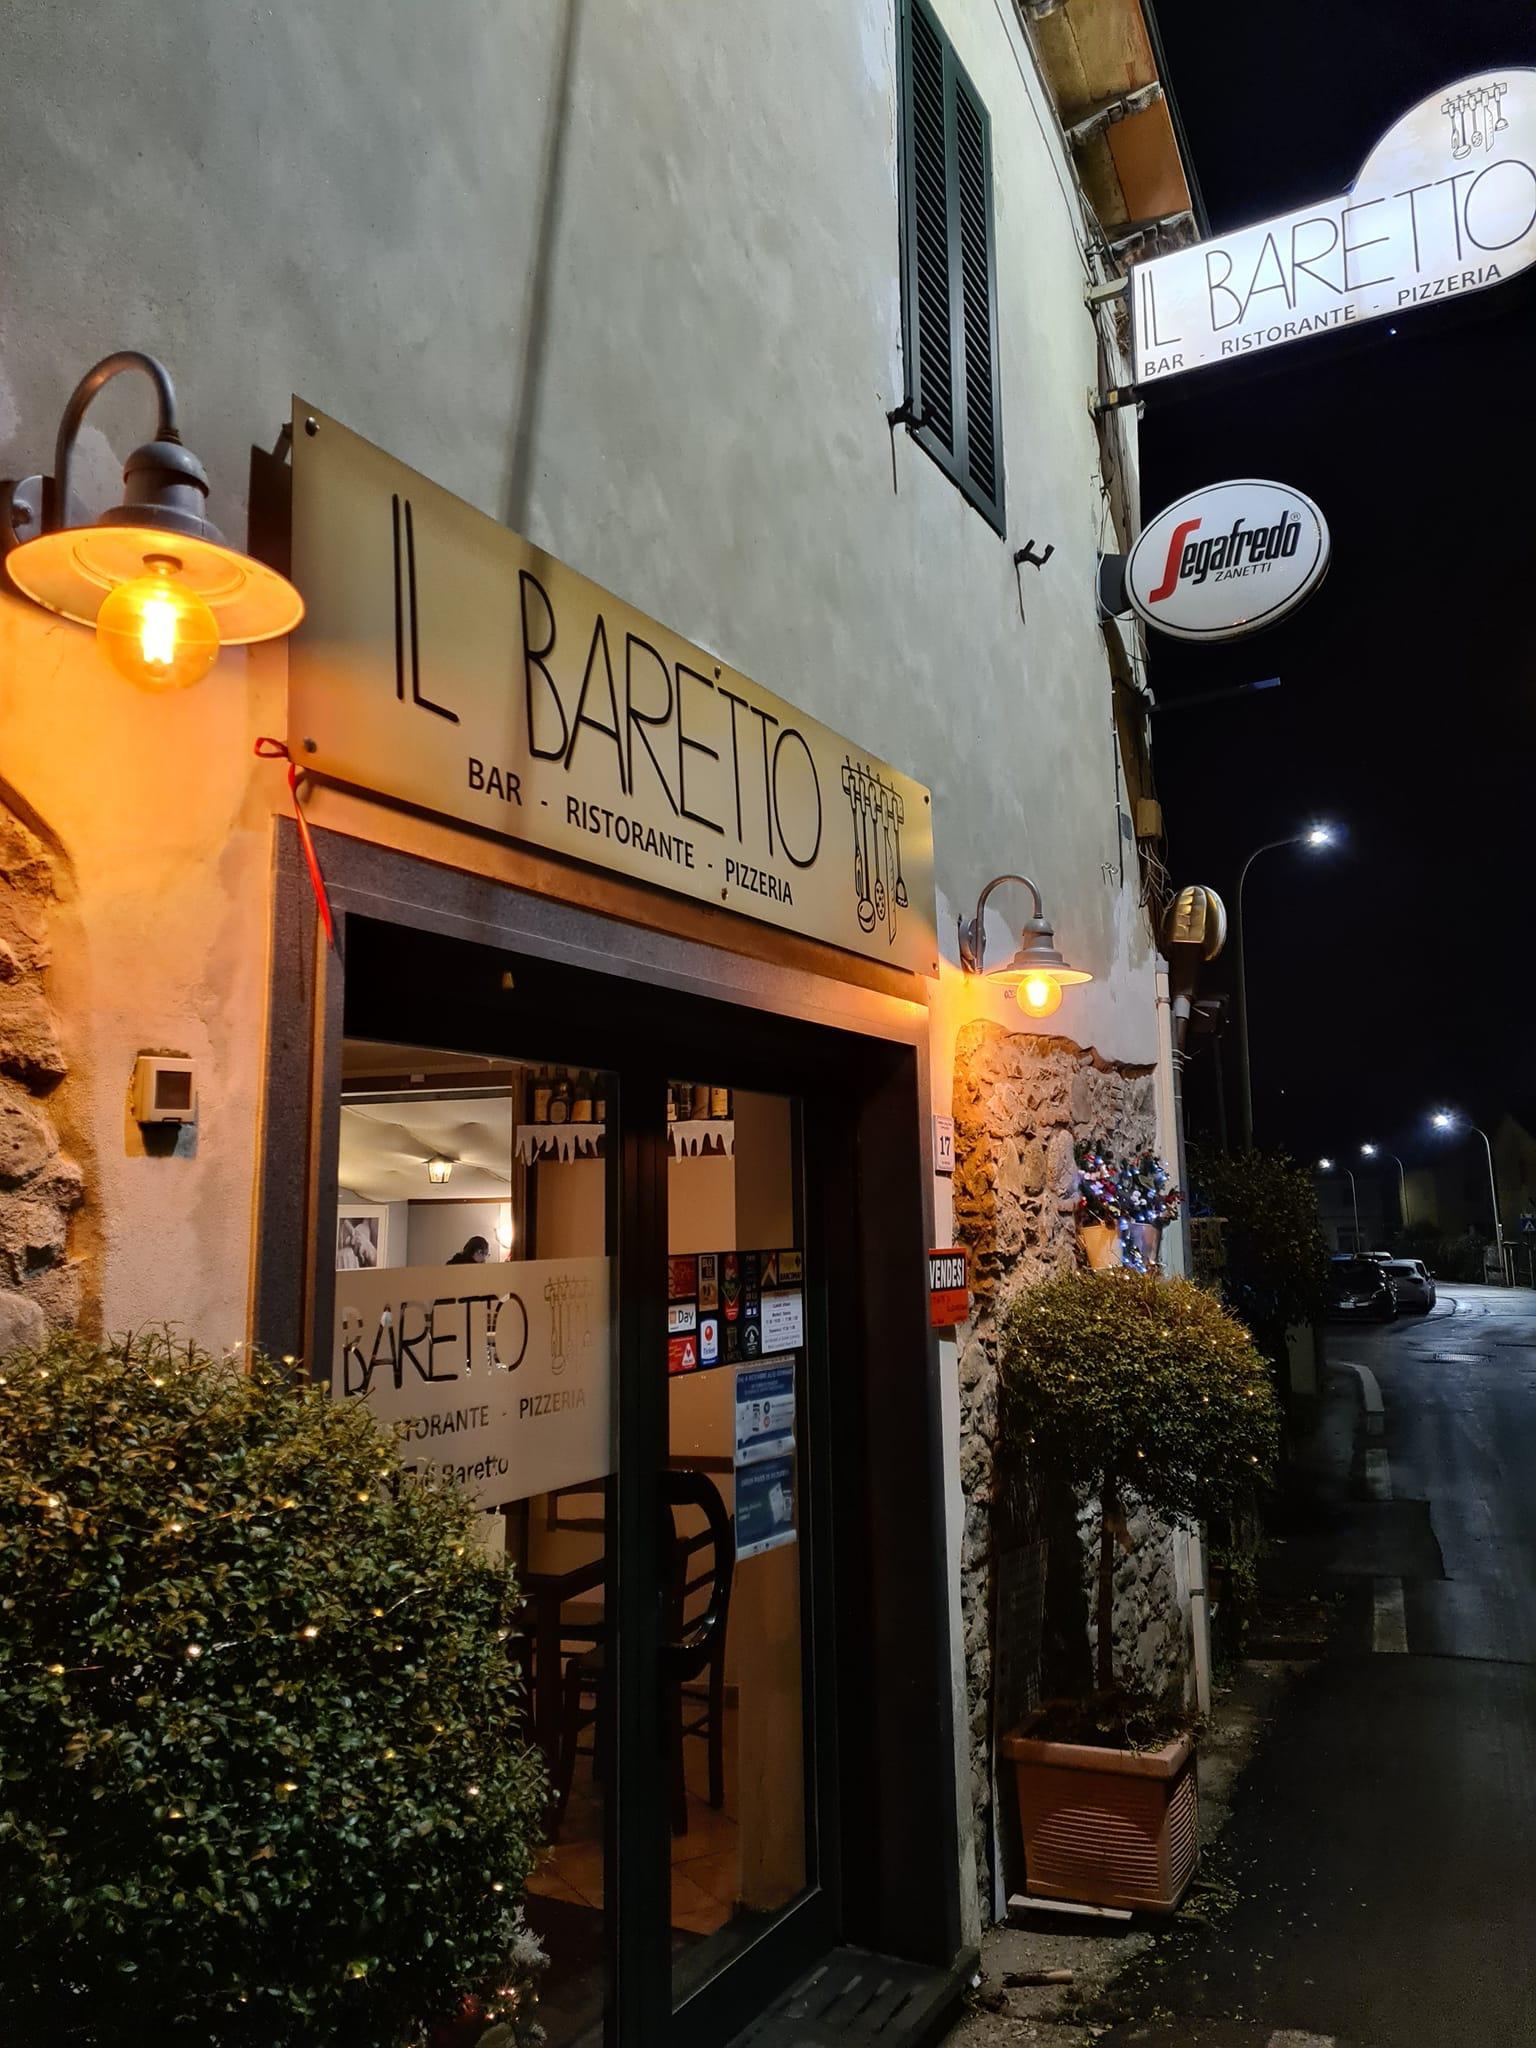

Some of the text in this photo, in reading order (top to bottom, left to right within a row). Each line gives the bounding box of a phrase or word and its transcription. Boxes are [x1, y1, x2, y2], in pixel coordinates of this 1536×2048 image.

[1141, 159, 1536, 351] IL BARETTO
[1144, 353, 1184, 377] BAR
[1221, 304, 1357, 356] RISTORANTE
[1398, 263, 1501, 306] PIZZERIA
[1149, 510, 1301, 604] Segafredo
[1214, 562, 1272, 582] ZANETTI
[391, 493, 822, 868] IL BARETTO
[468, 756, 522, 807] BAR
[566, 795, 695, 869] RISTORANTE
[725, 857, 793, 907] PIZZERIA
[940, 1136, 950, 1156] 17
[678, 1310, 694, 1326] Day
[929, 1258, 965, 1290] VENDESI
[342, 1292, 529, 1397] BARETTO
[519, 1389, 585, 1420] PIZZERIA
